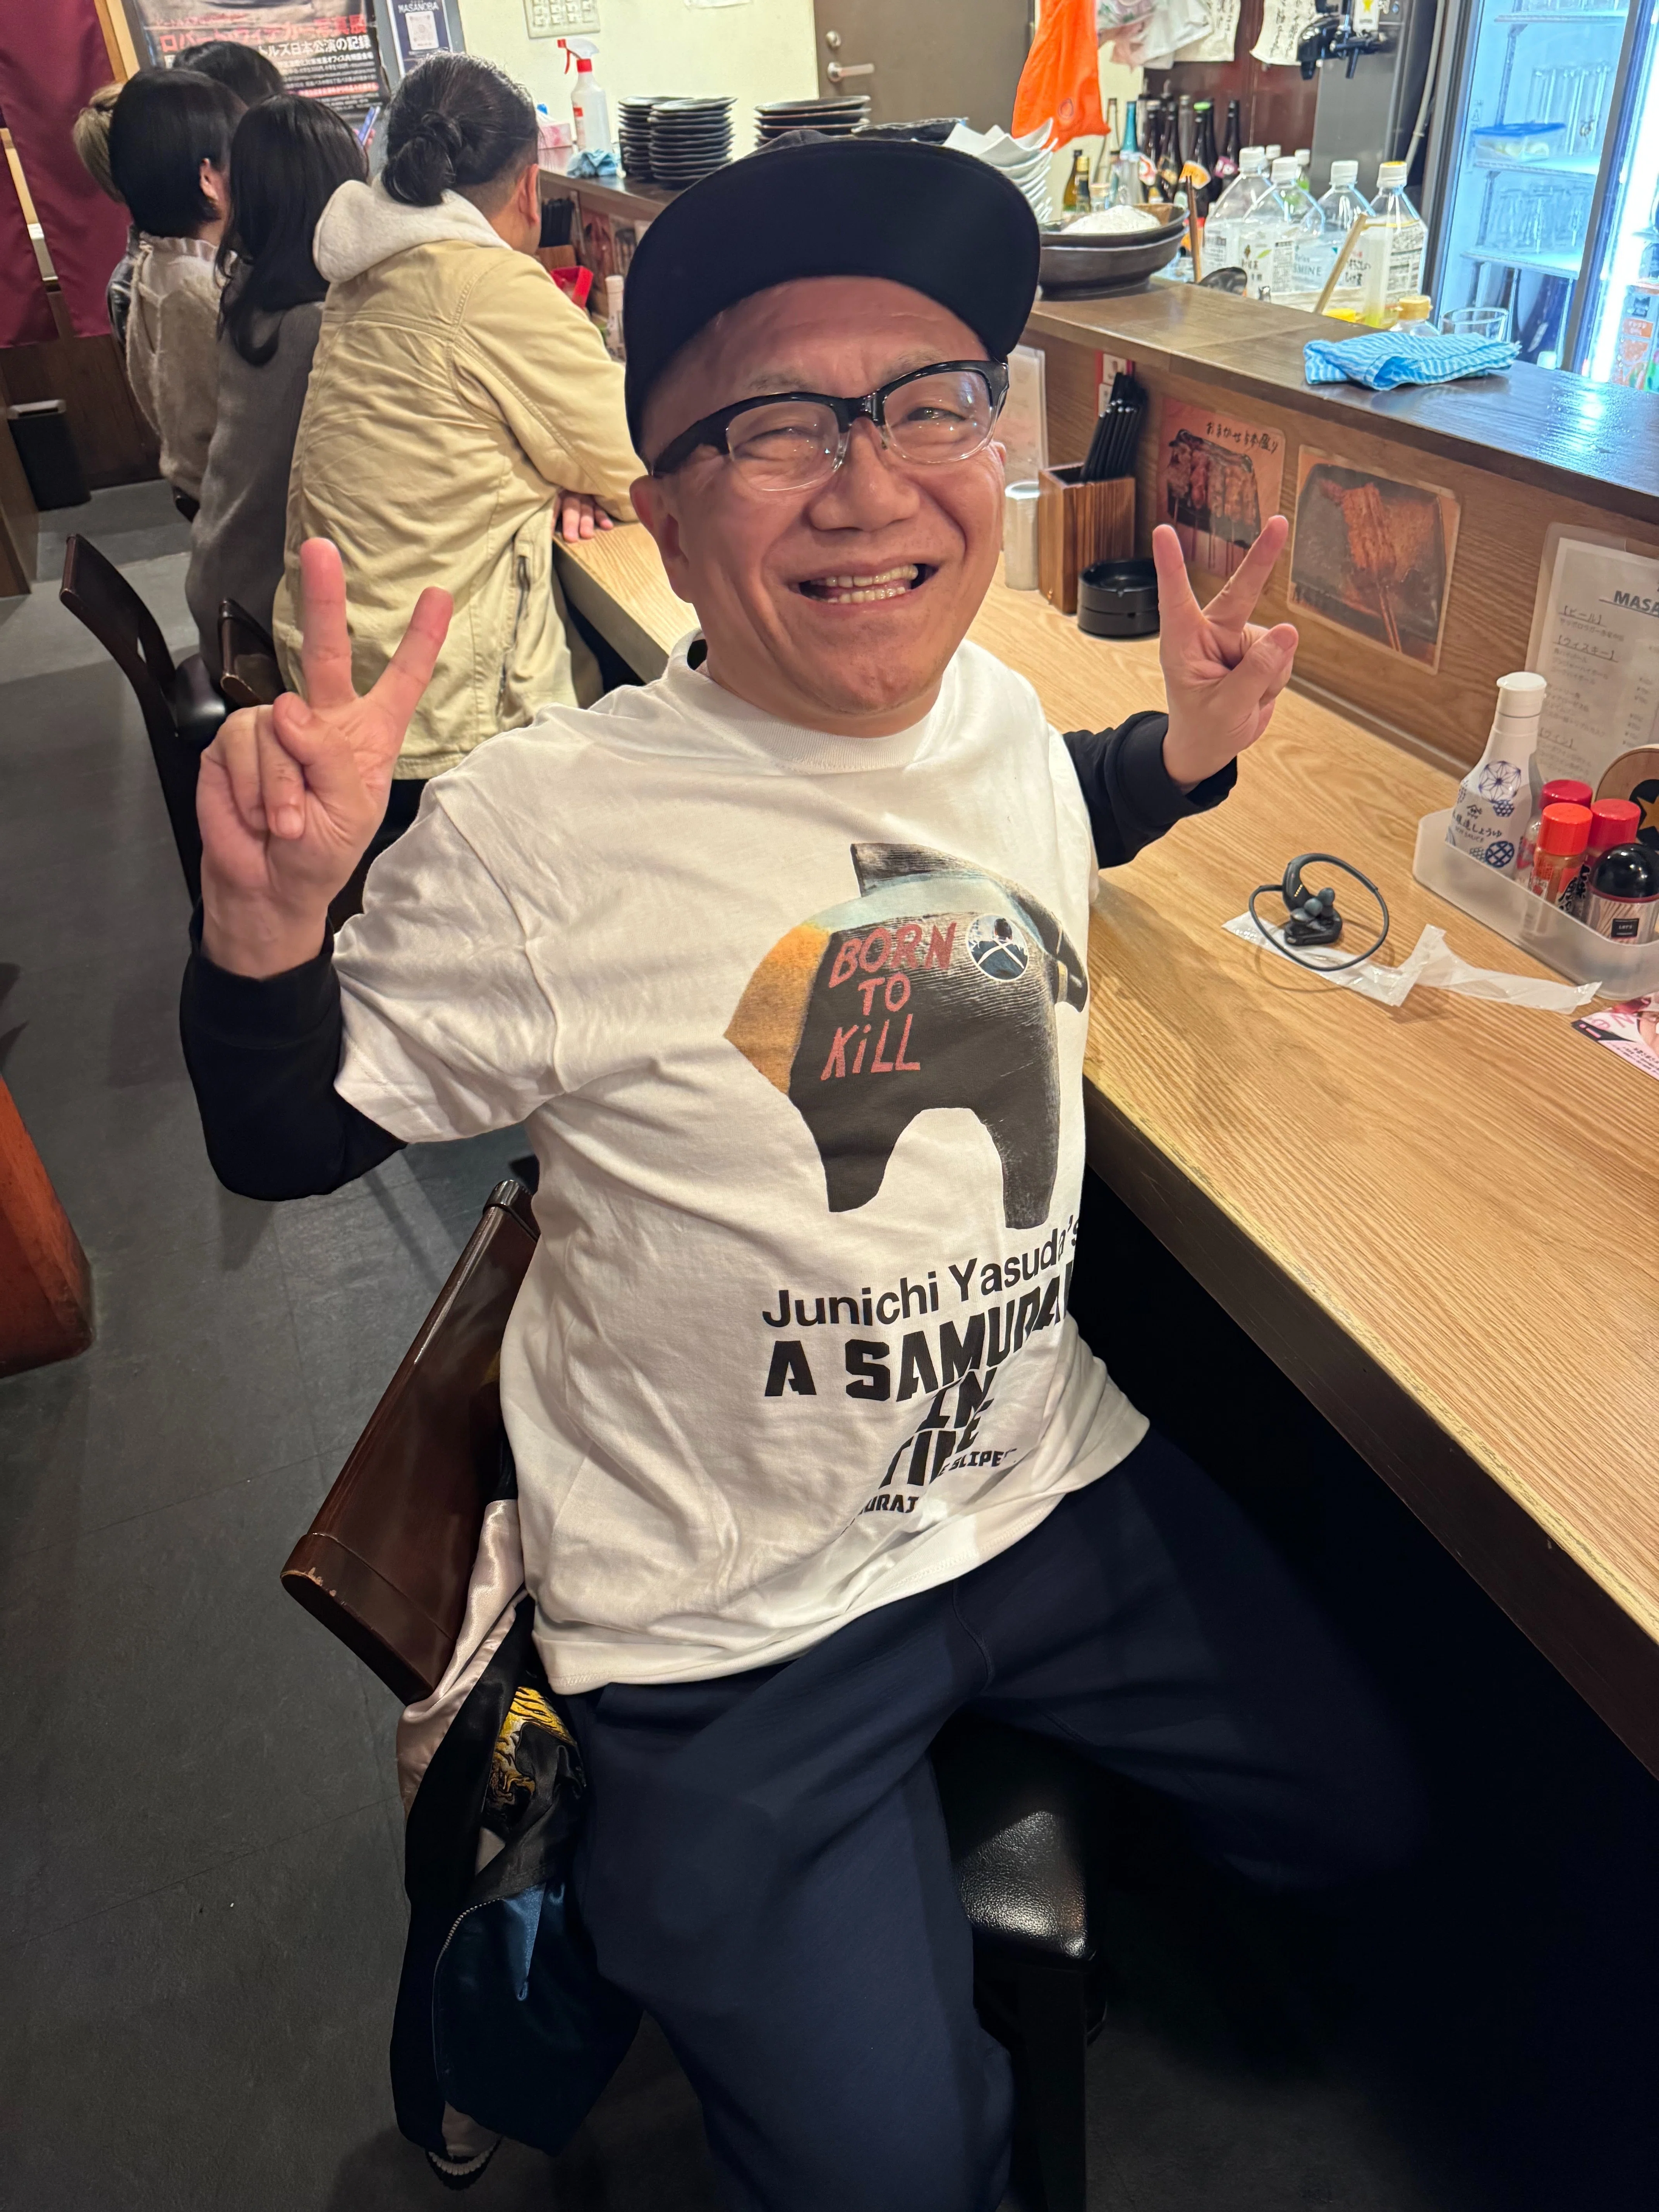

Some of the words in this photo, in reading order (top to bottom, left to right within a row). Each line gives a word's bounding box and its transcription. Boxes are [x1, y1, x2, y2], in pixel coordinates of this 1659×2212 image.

[258, 34, 371, 57] トルズ日本公演の記録
[828, 922, 958, 988] BORN
[858, 972, 911, 1016] TO
[762, 1270, 938, 1328] Junichi
[764, 1340, 816, 1397] A
